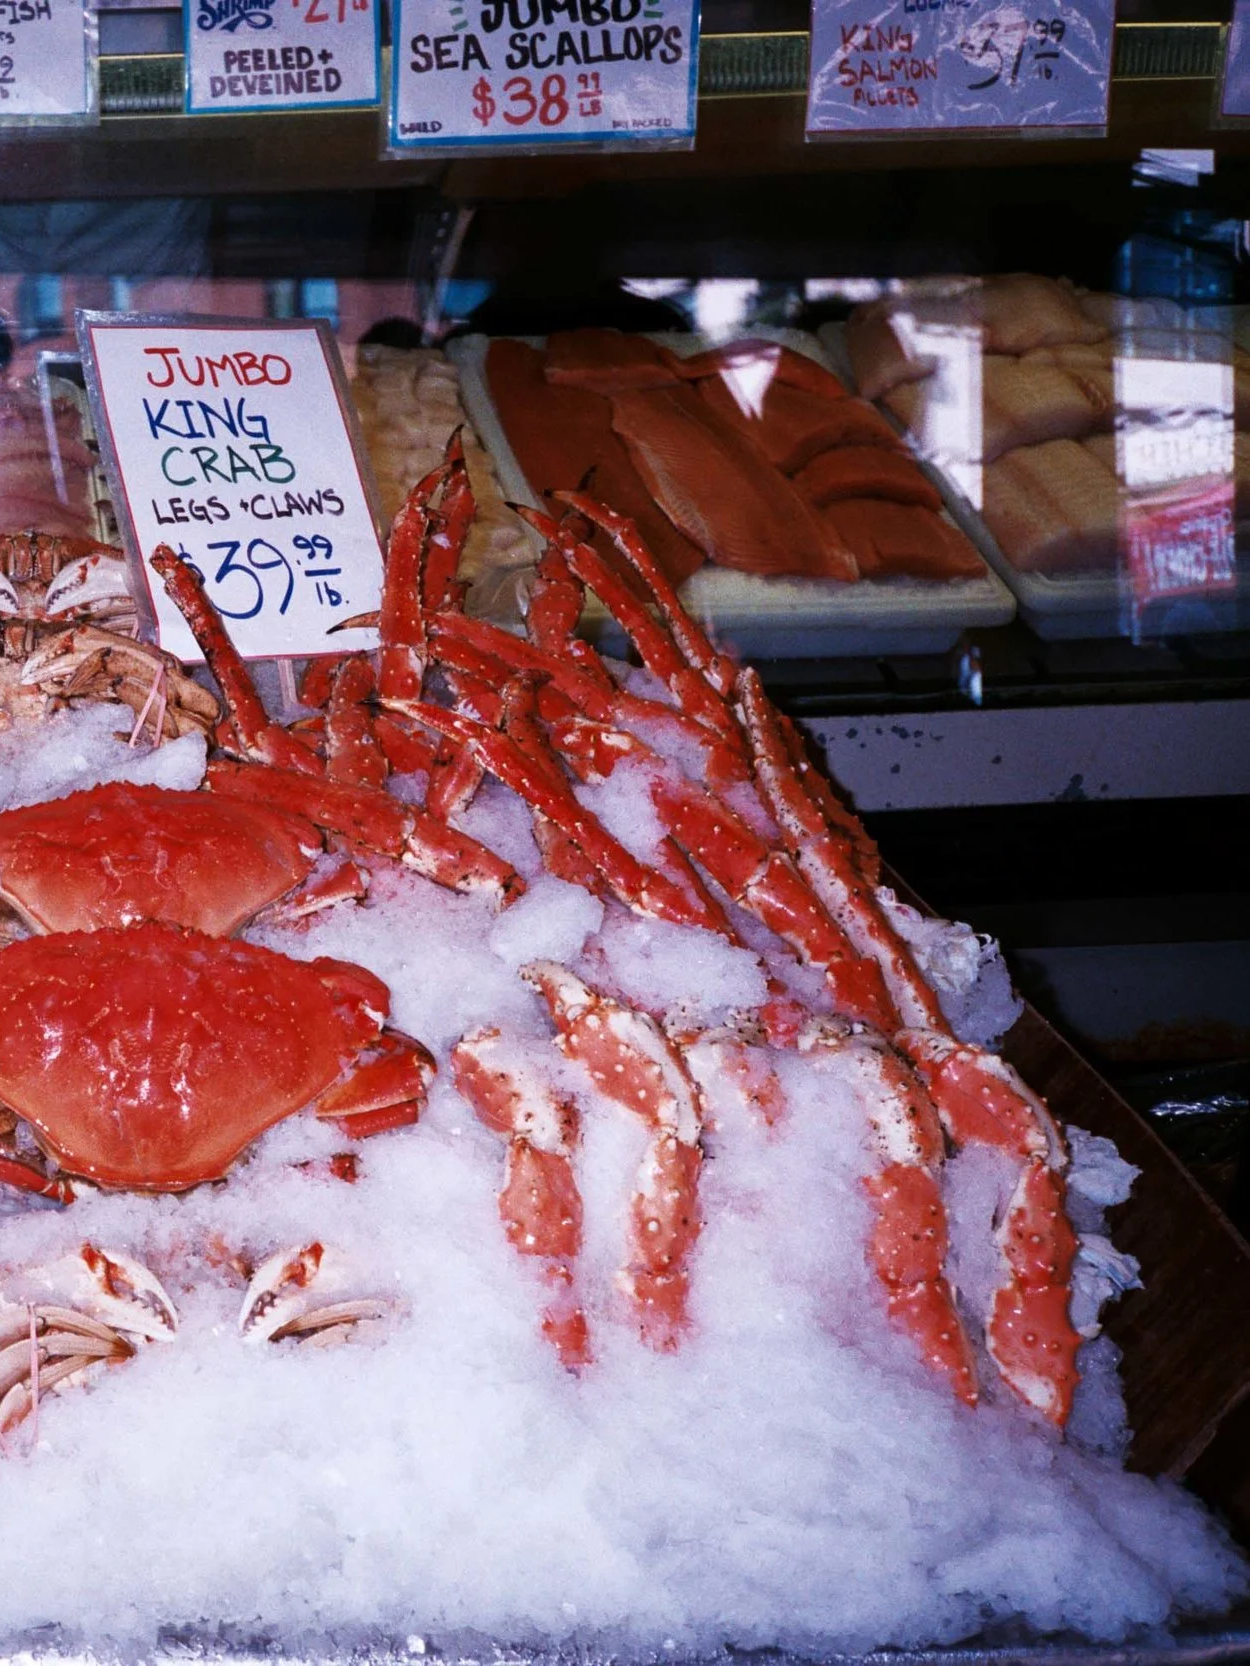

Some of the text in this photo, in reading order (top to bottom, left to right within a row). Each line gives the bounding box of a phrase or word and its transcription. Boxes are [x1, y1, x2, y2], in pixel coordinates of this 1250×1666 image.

[480, 0, 641, 33] JUMBO
[410, 25, 682, 73] SEA SCALLOPS
[840, 23, 913, 52] KING
[209, 68, 342, 98] DEVEINED
[838, 57, 938, 88] SALMON
[578, 100, 602, 118] LB
[144, 347, 292, 388] JUMBO
[142, 398, 272, 443] KING
[161, 444, 297, 486] CRAB
[152, 496, 230, 525] LEGS
